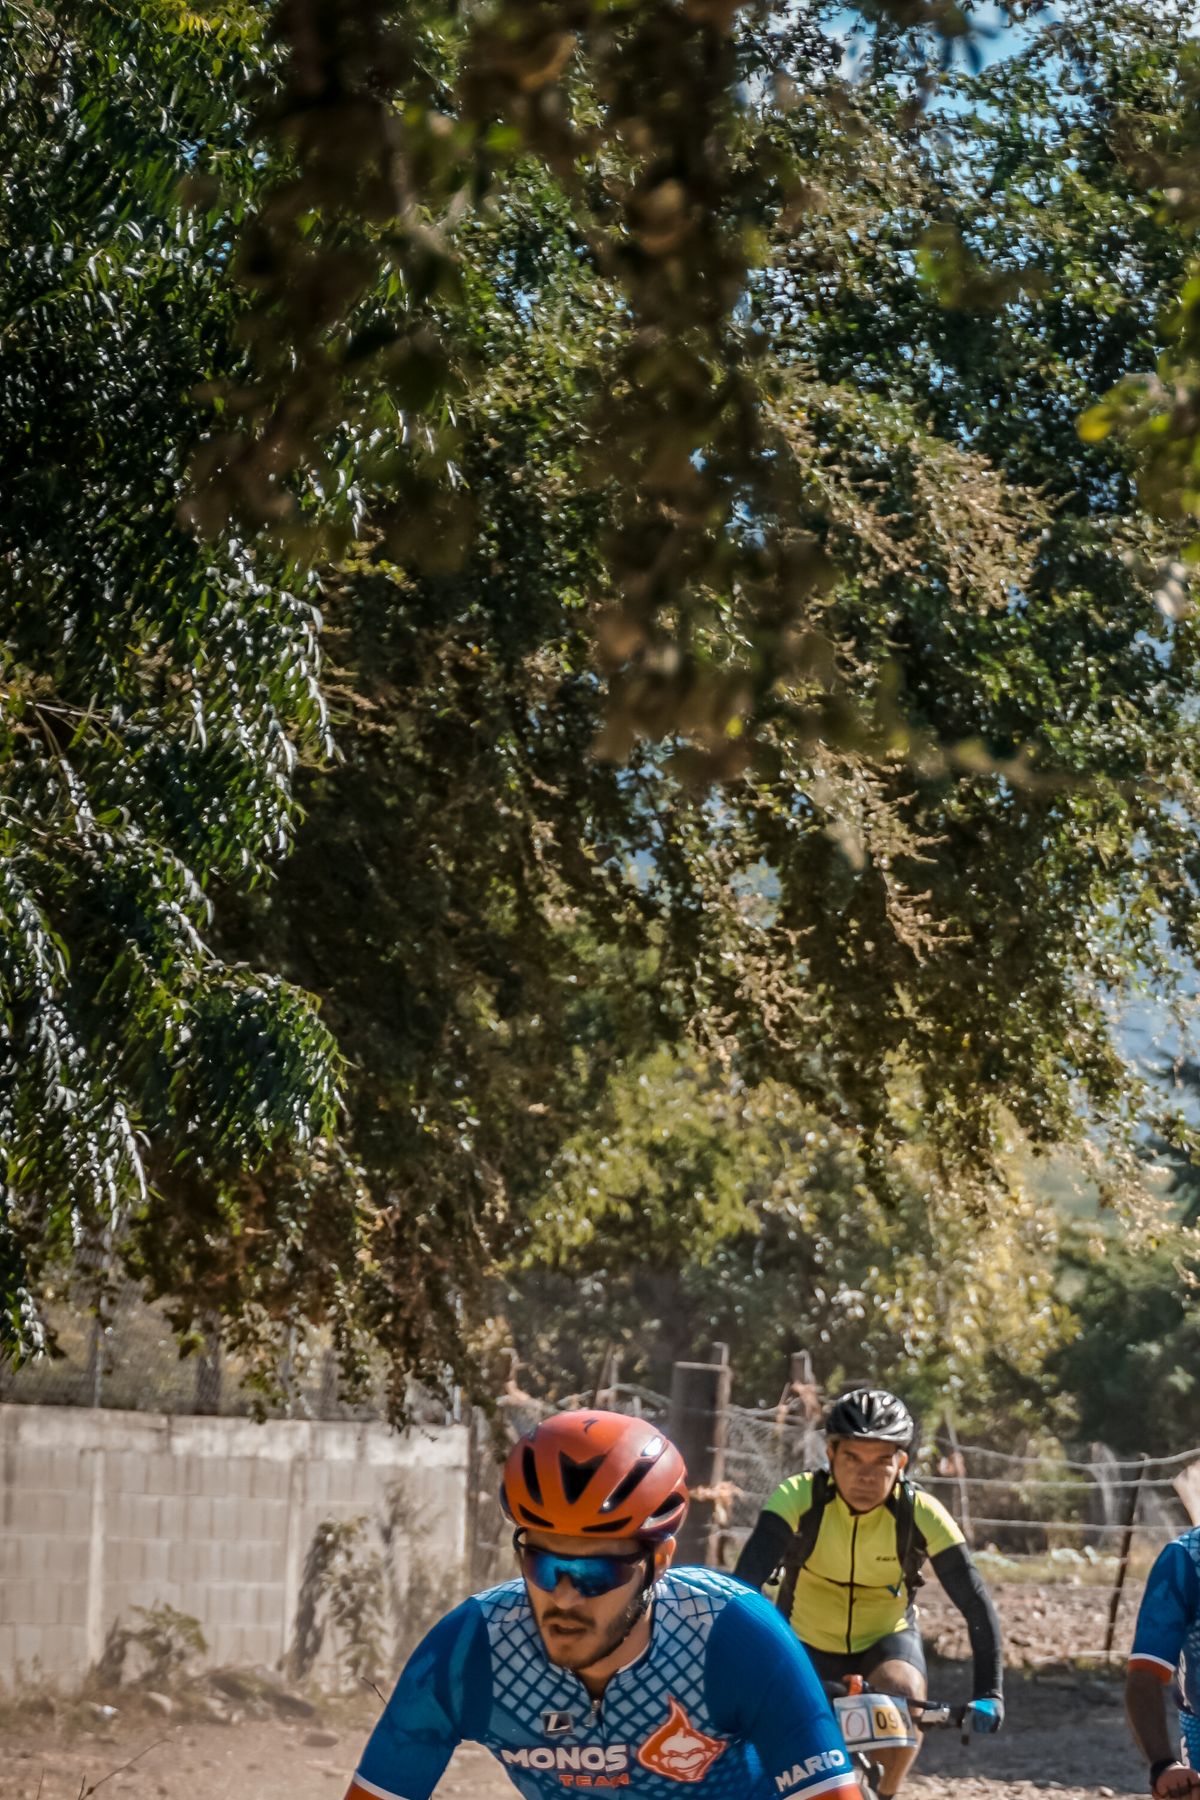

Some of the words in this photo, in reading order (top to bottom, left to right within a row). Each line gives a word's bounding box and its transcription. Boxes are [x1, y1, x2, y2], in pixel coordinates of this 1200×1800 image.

[501, 1744, 629, 1772] MONOS
[775, 1749, 845, 1792] MARIO
[559, 1773, 630, 1789] TEAM
